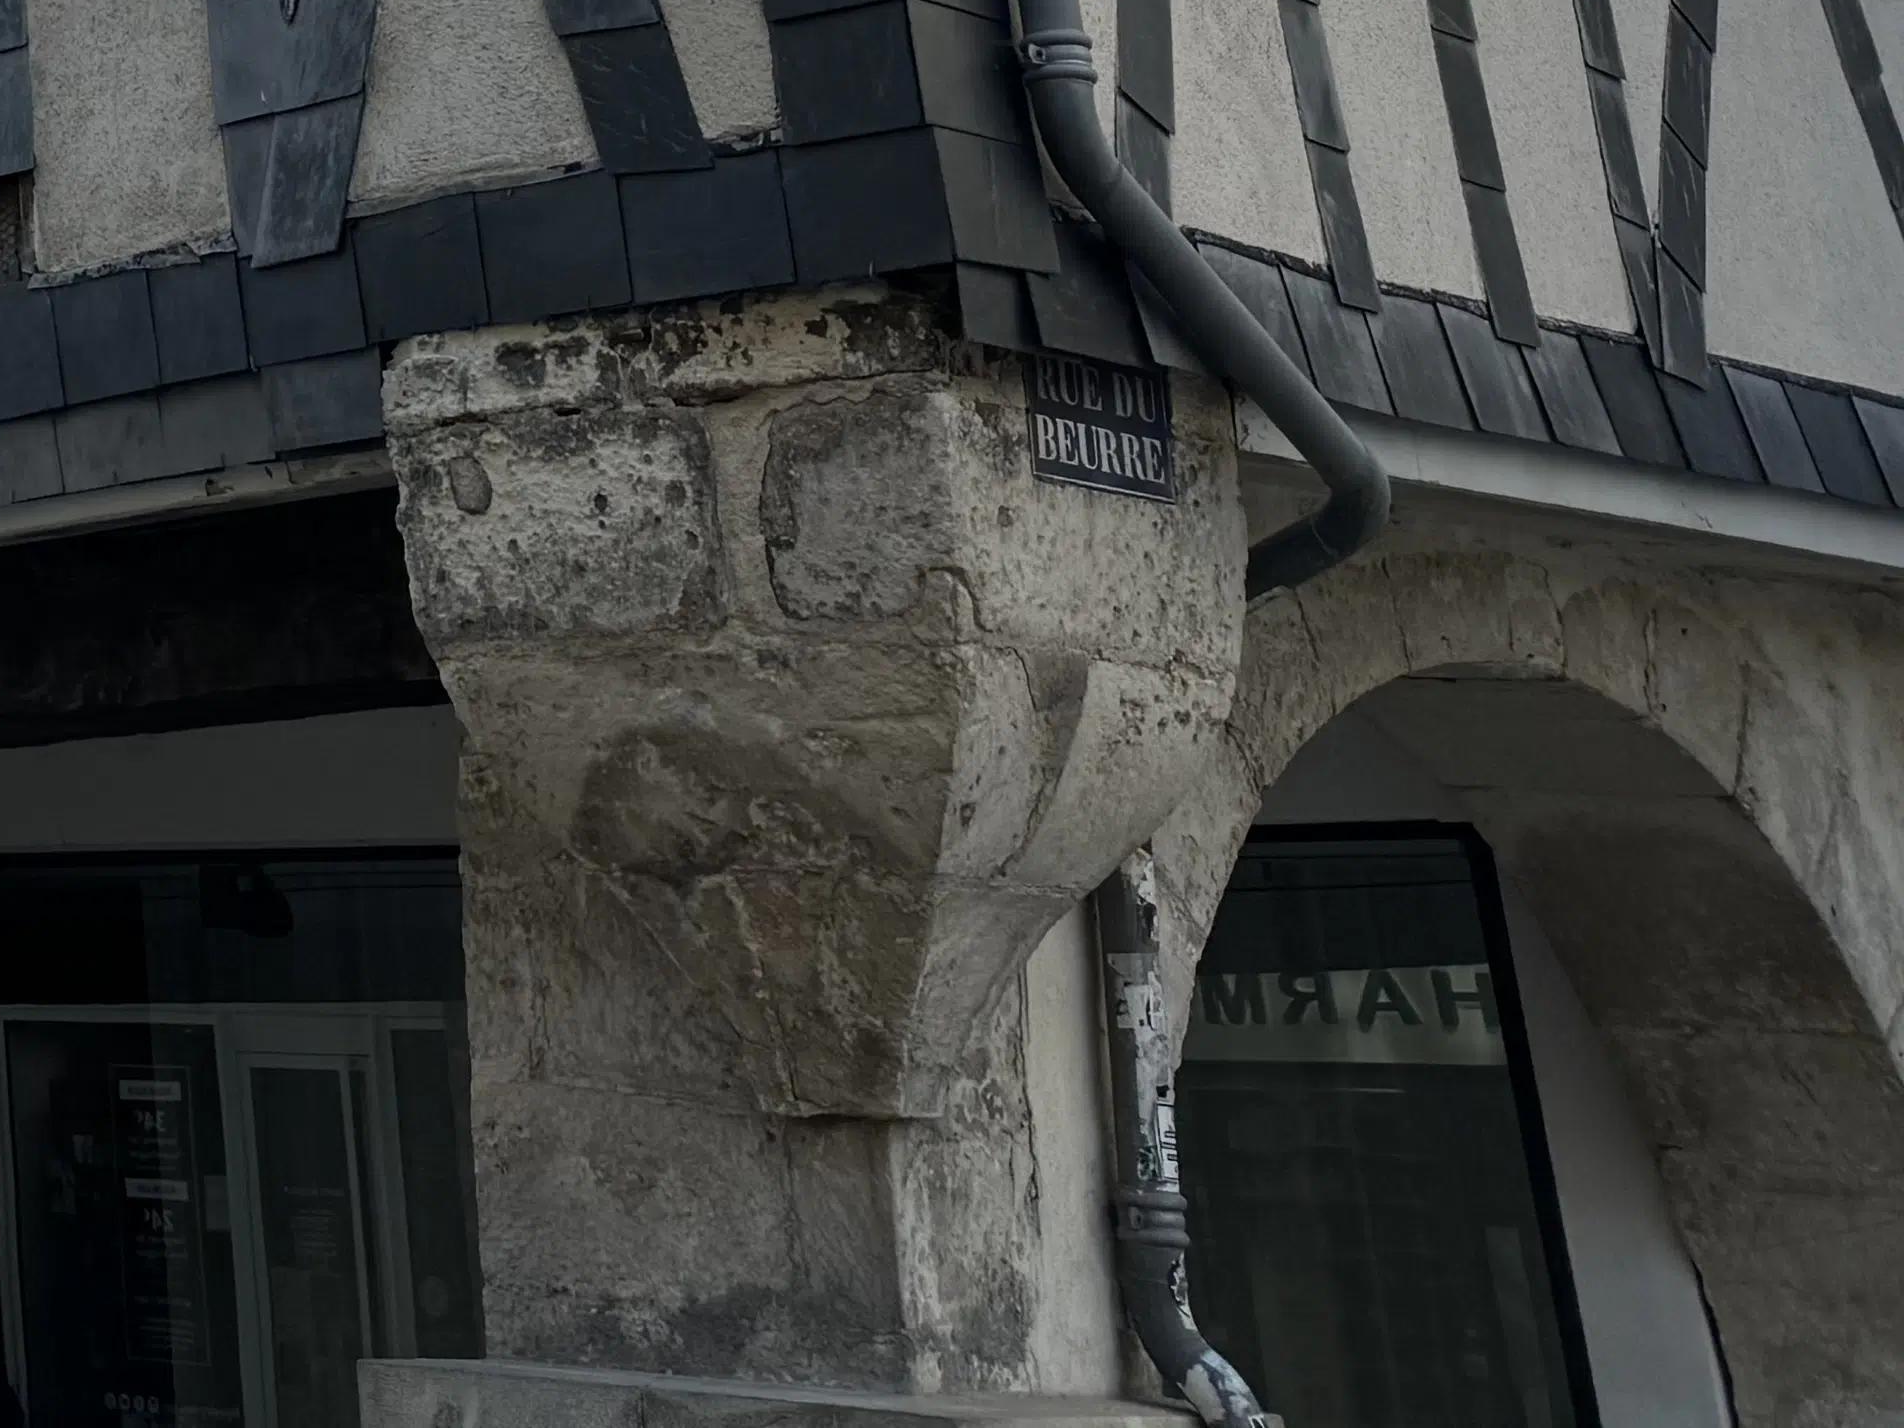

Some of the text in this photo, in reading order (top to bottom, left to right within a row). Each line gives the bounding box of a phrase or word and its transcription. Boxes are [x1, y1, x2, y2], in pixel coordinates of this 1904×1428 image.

[1038, 356, 1156, 424] RUE DU
[1035, 414, 1165, 484] BEURRE
